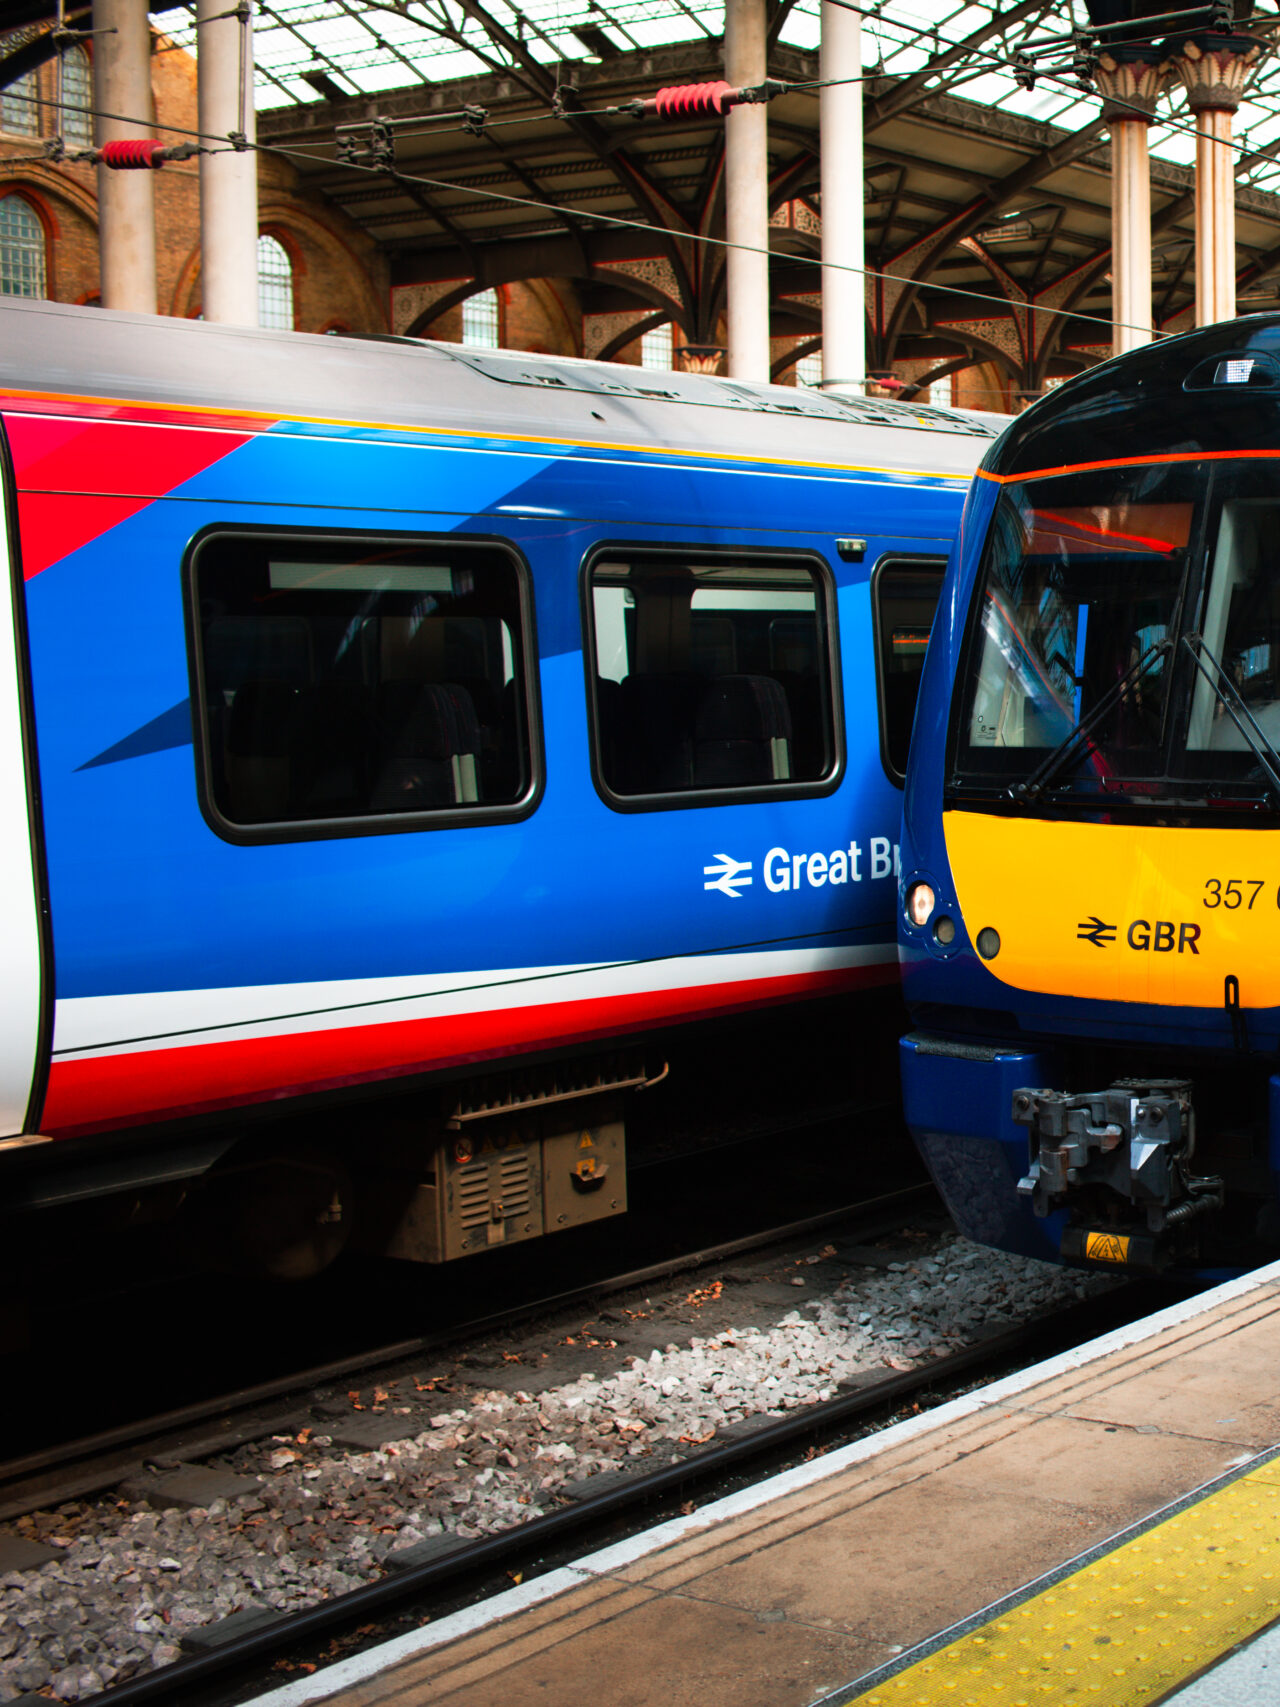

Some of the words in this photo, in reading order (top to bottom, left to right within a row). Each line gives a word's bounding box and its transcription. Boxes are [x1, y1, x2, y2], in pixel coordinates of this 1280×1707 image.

[763, 840, 862, 893] Great
[1203, 878, 1264, 910] 357
[1127, 919, 1202, 955] GBR
